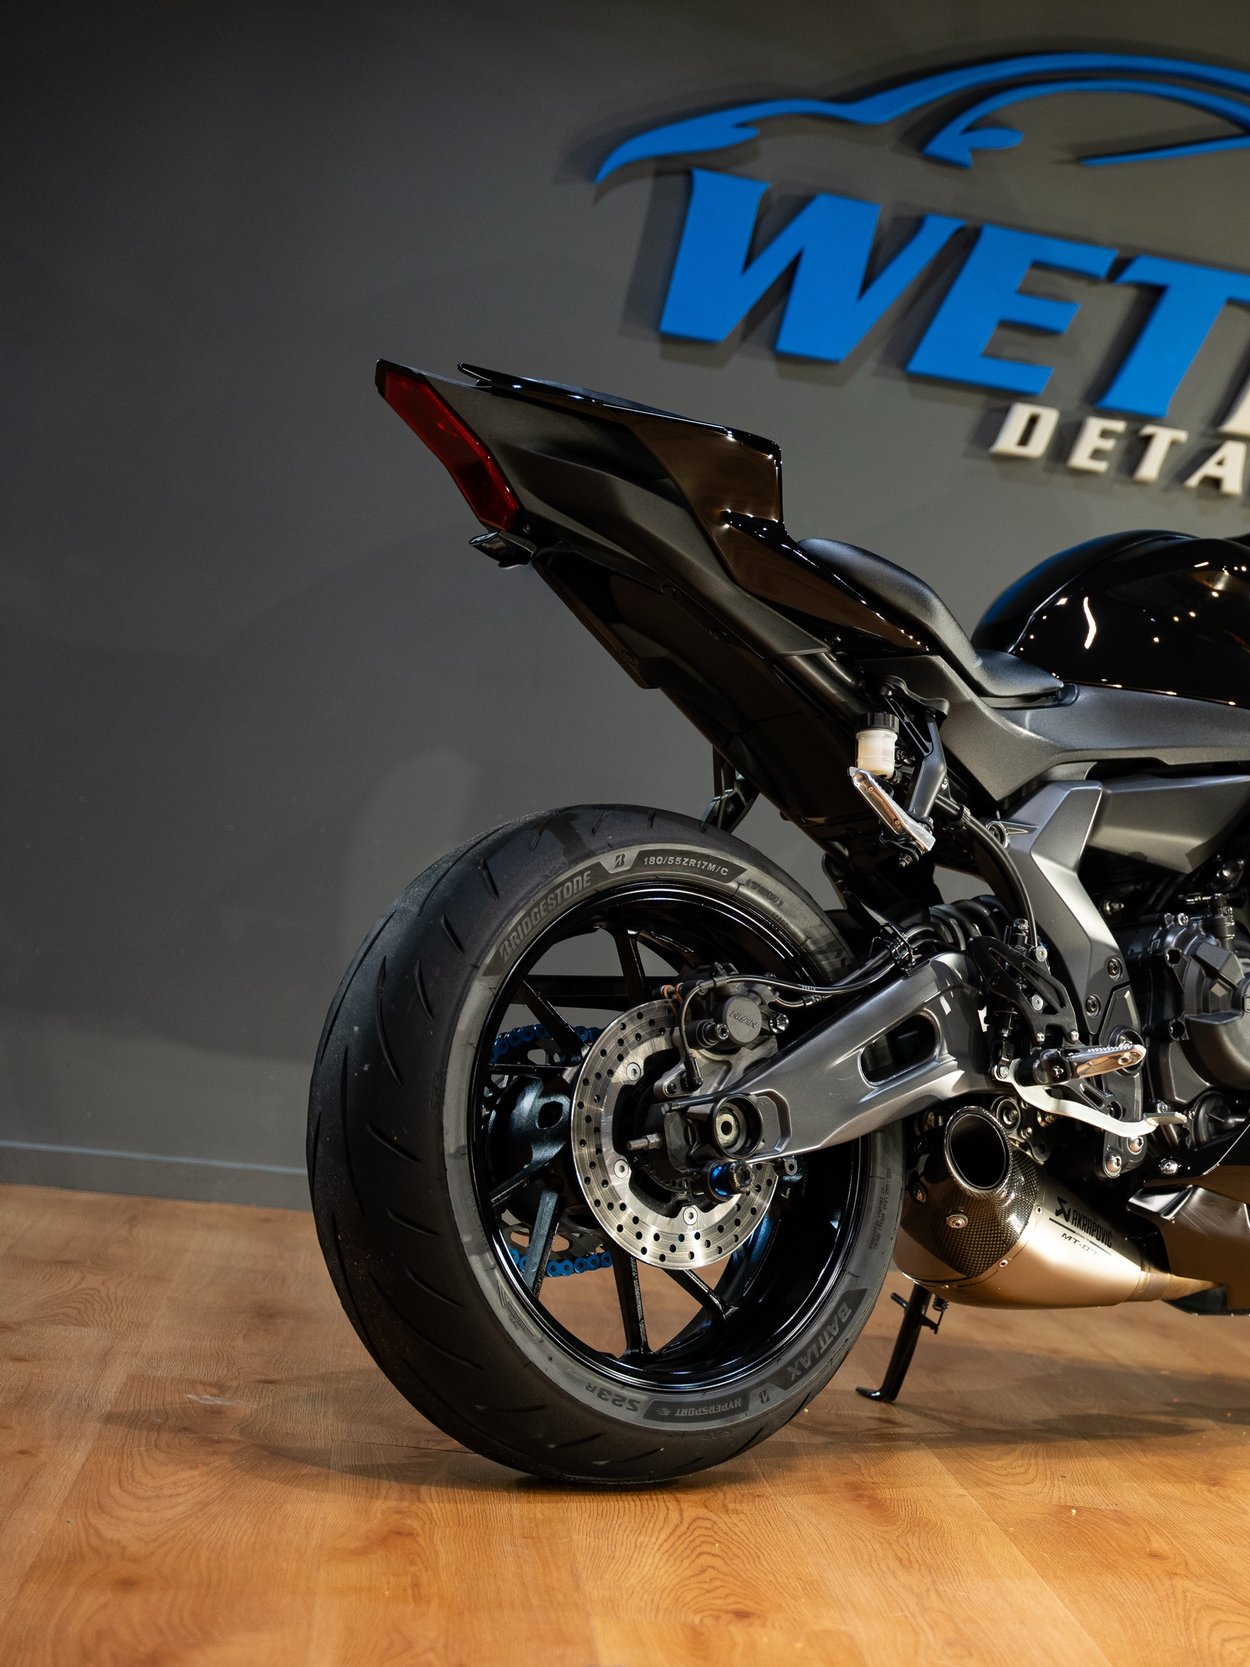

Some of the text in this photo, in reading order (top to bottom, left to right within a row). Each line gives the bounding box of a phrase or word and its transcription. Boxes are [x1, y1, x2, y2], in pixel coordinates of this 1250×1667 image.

[500, 870, 592, 963] BRIDGESTONE
[787, 1301, 852, 1381] BATTLAX
[674, 1398, 742, 1417] HYPERSPORT
